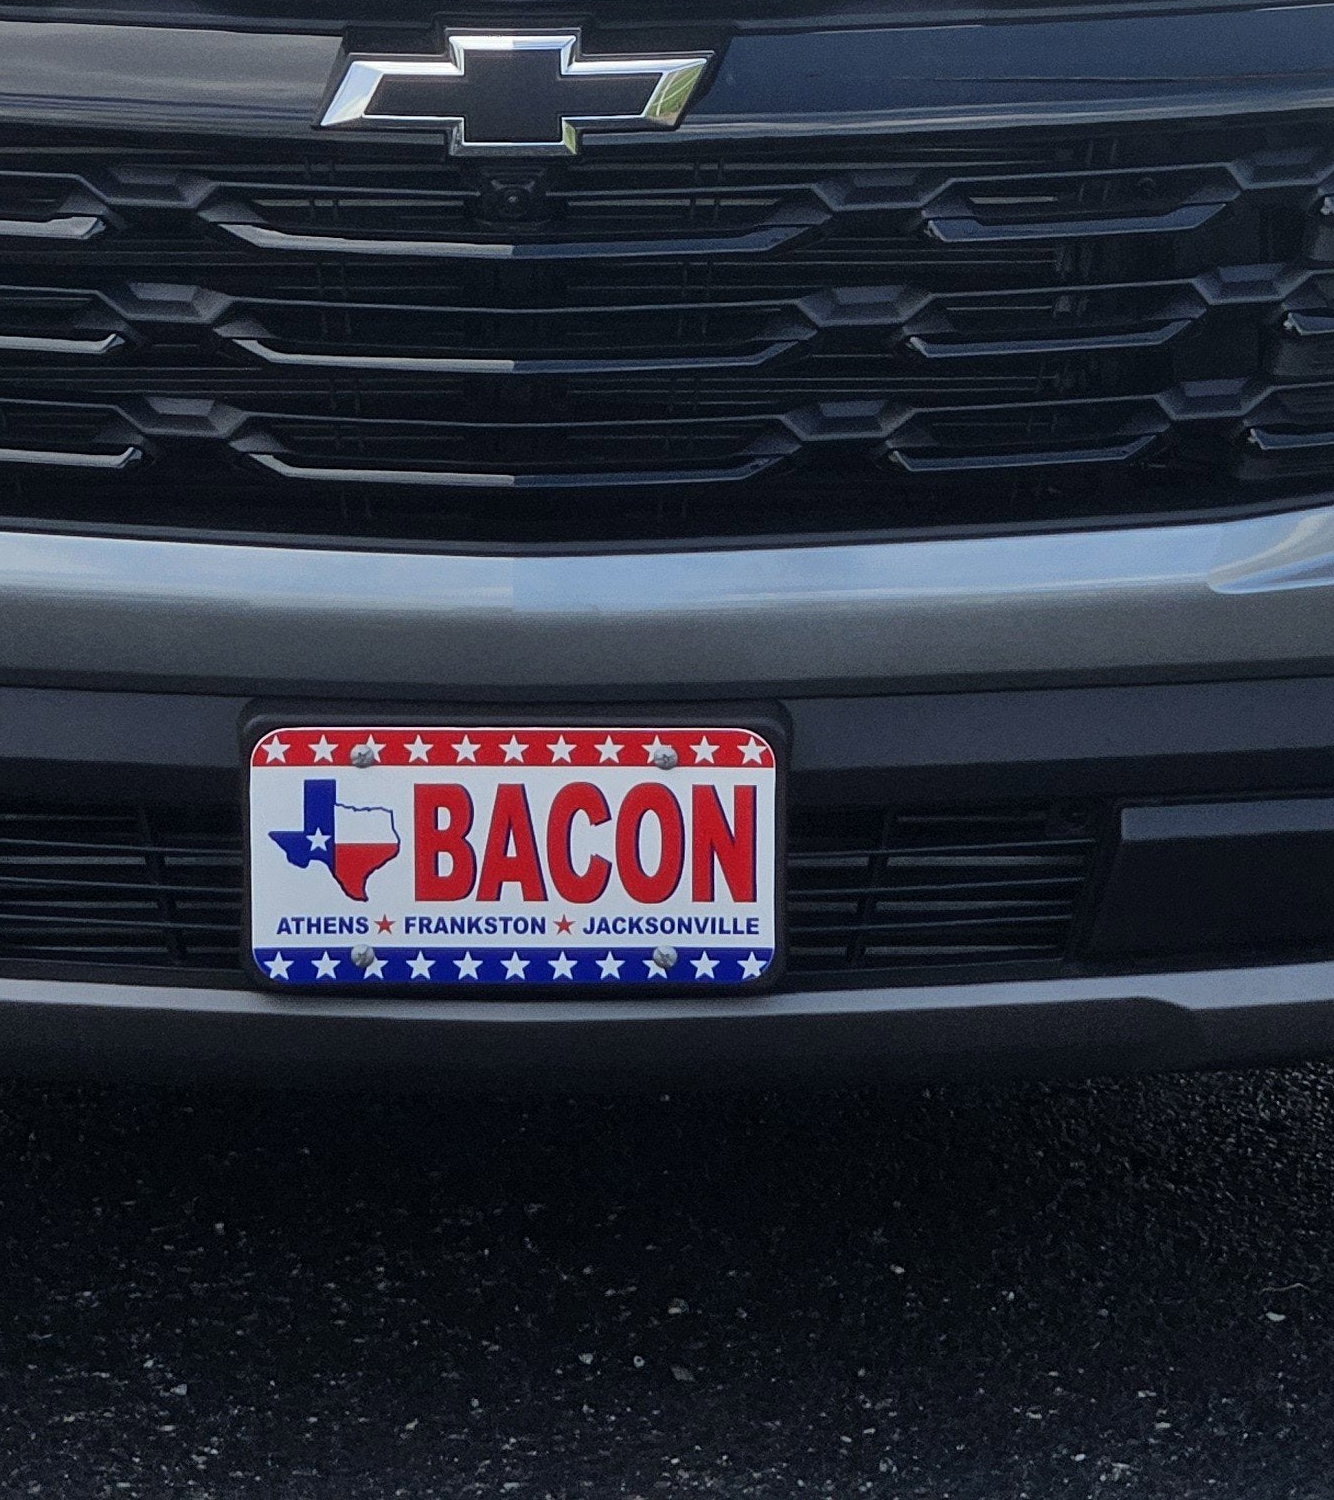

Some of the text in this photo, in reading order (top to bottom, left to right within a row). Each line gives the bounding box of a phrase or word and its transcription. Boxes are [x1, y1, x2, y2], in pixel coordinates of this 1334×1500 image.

[414, 781, 758, 904] BACON
[277, 916, 760, 936] ATHENS FRANKSTON JACKSONVILLE
